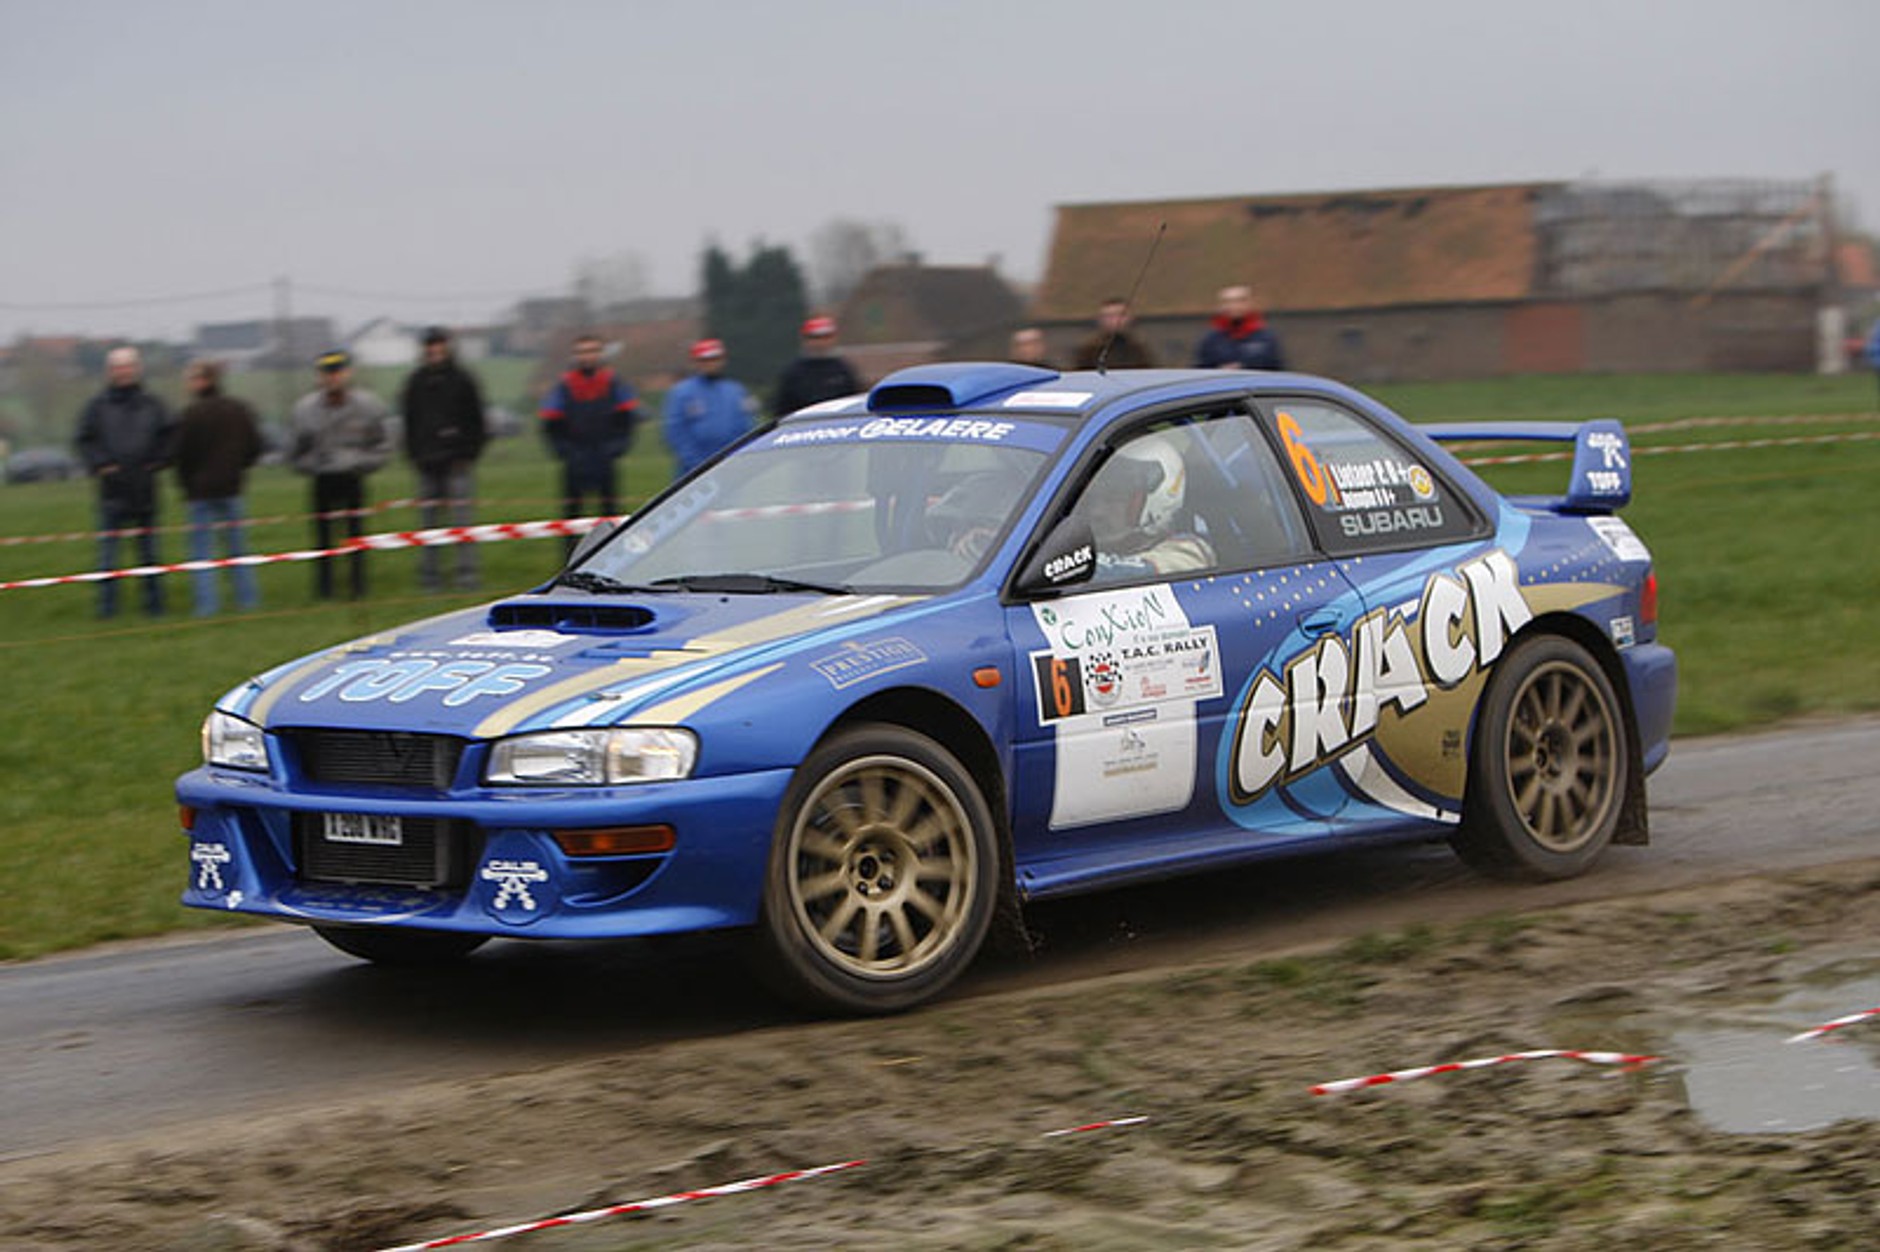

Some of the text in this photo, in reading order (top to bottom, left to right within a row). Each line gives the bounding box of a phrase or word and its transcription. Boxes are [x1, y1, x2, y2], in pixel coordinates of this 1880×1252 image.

[1277, 412, 1327, 506] 6
[1340, 506, 1444, 537] SUBARU
[1044, 545, 1092, 577] CRACK
[1121, 637, 1208, 660] T.A.C. RALLY
[299, 658, 553, 707] TOFF
[1051, 658, 1073, 718] 6
[1235, 550, 1534, 797] CRACK
